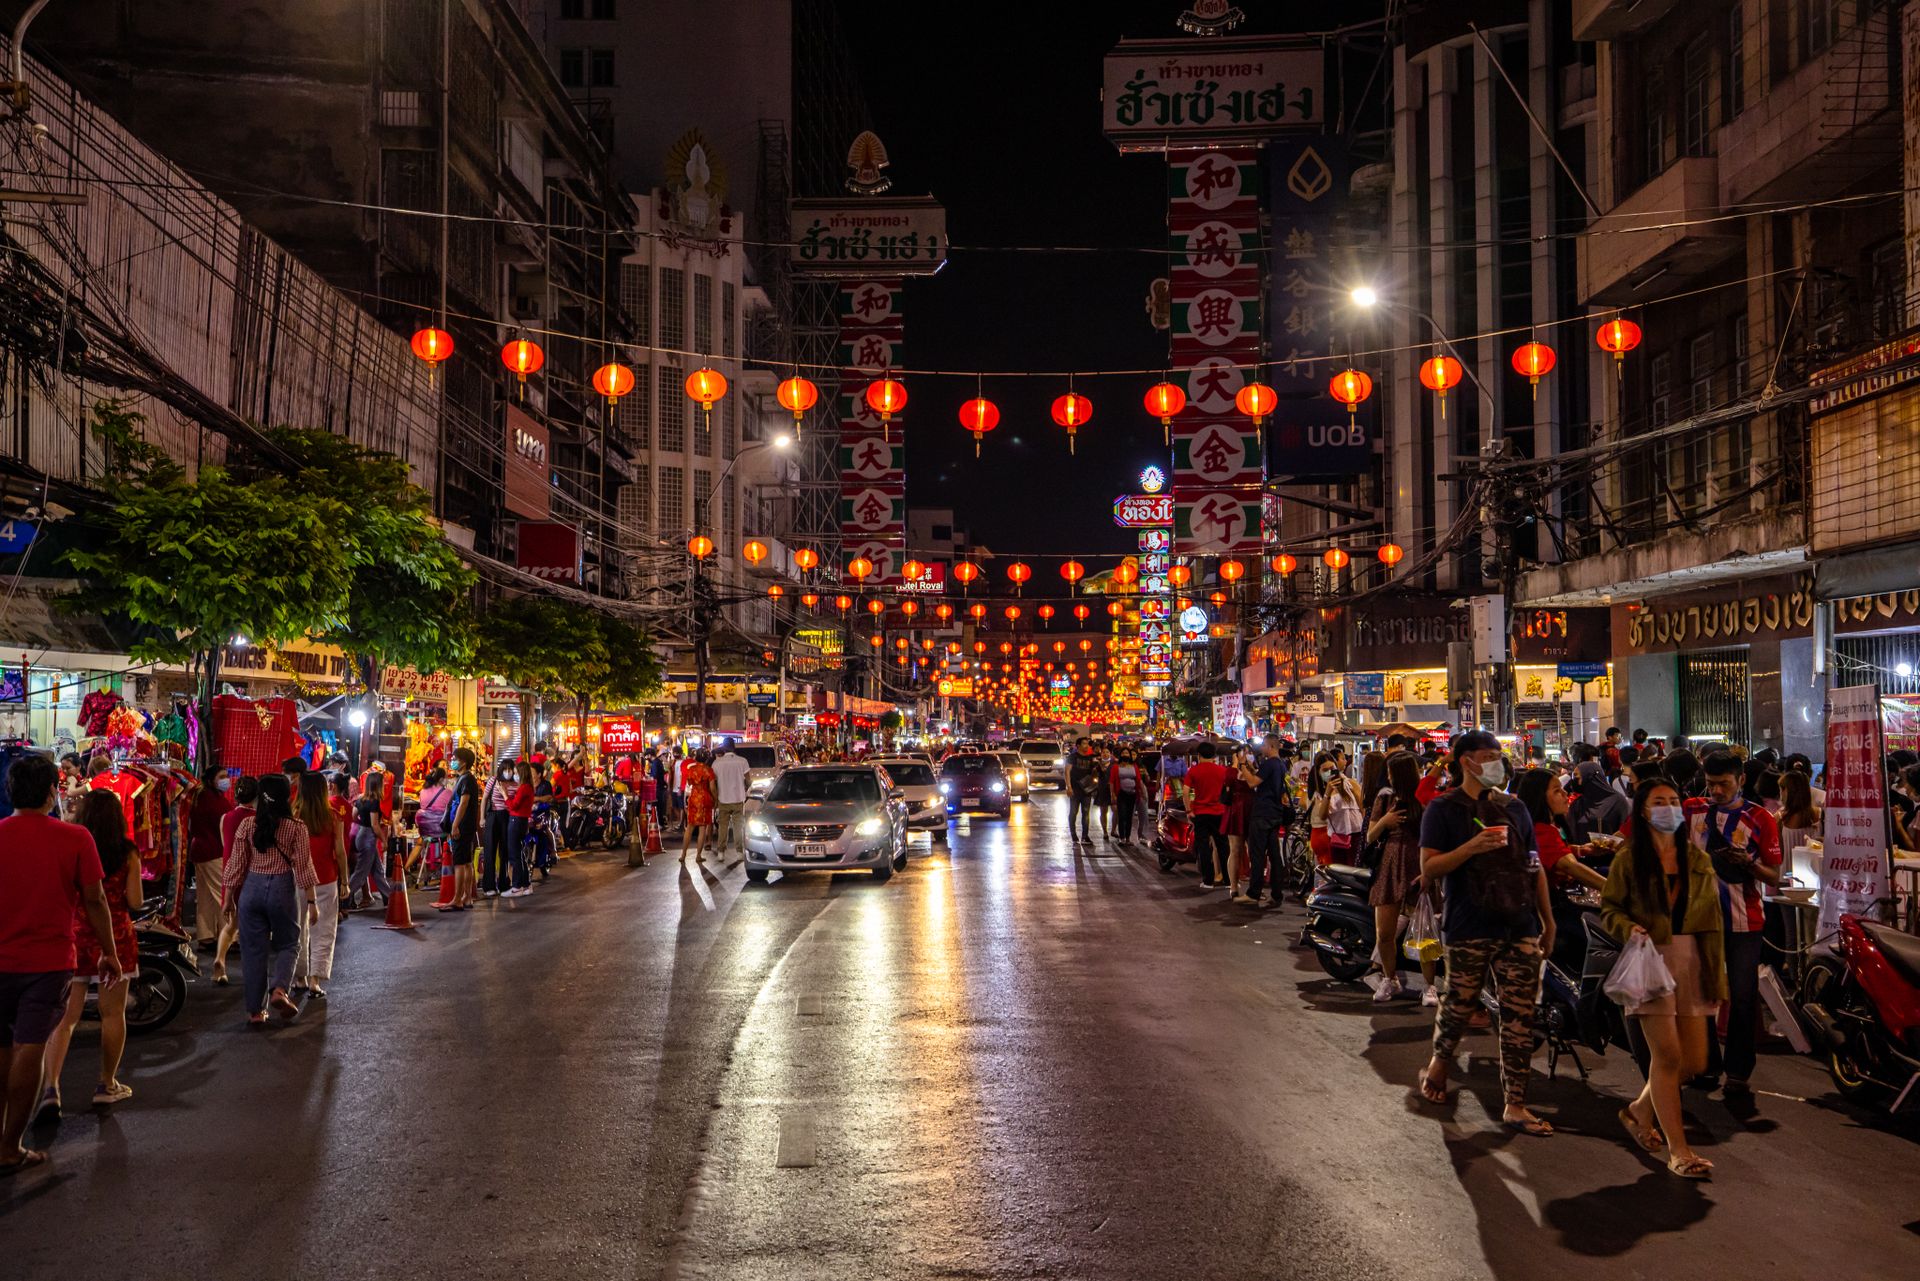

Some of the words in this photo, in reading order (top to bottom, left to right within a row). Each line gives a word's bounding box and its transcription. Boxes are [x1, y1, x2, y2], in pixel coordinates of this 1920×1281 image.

[1158, 59, 1264, 80] ห้างขายทอง
[1116, 69, 1313, 126] ฮั่วเซ่งเฮง
[829, 212, 910, 228] ห้างขายทอง
[799, 218, 938, 260] ฮั่วเซ่งเฮง
[1308, 425, 1366, 447] UOB
[0, 520, 17, 542] 4
[919, 581, 944, 590] Royal
[393, 688, 420, 697] JAWAAJ
